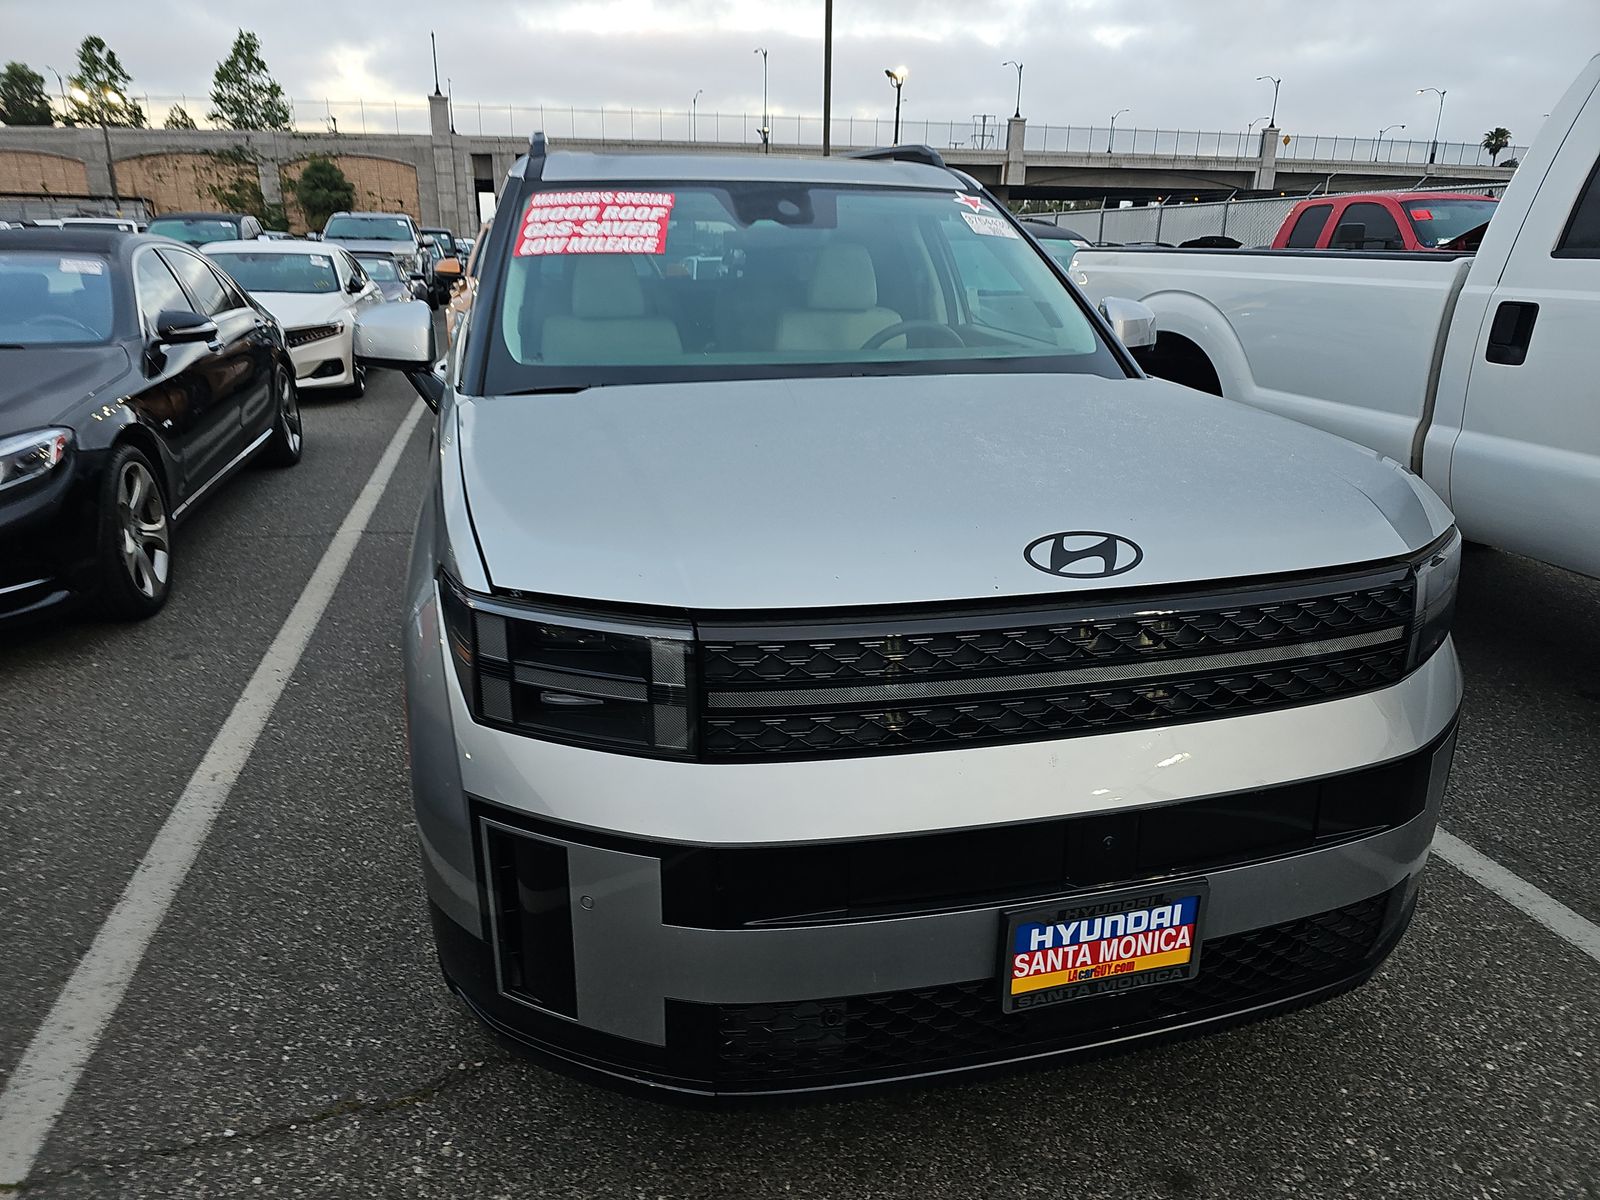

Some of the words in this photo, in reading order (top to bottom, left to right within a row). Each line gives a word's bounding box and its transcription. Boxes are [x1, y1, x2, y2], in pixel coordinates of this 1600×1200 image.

[532, 192, 613, 206] MANAGER'S
[615, 192, 673, 206] SPECIAL
[526, 206, 600, 222] MOON
[601, 206, 668, 221] ROOF
[523, 221, 661, 238] GAS-SAVER
[519, 237, 569, 255] LOW
[566, 237, 659, 253] MILEAGE
[1064, 896, 1156, 920] HYUNDAI
[1029, 904, 1182, 951] HYUNDAI
[1014, 945, 1091, 978] SANTA
[1099, 926, 1191, 962] MONICA
[1067, 961, 1135, 982] LAcarGUY.com
[1018, 985, 1090, 1008] SANTA
[1096, 968, 1184, 992] MONICA
